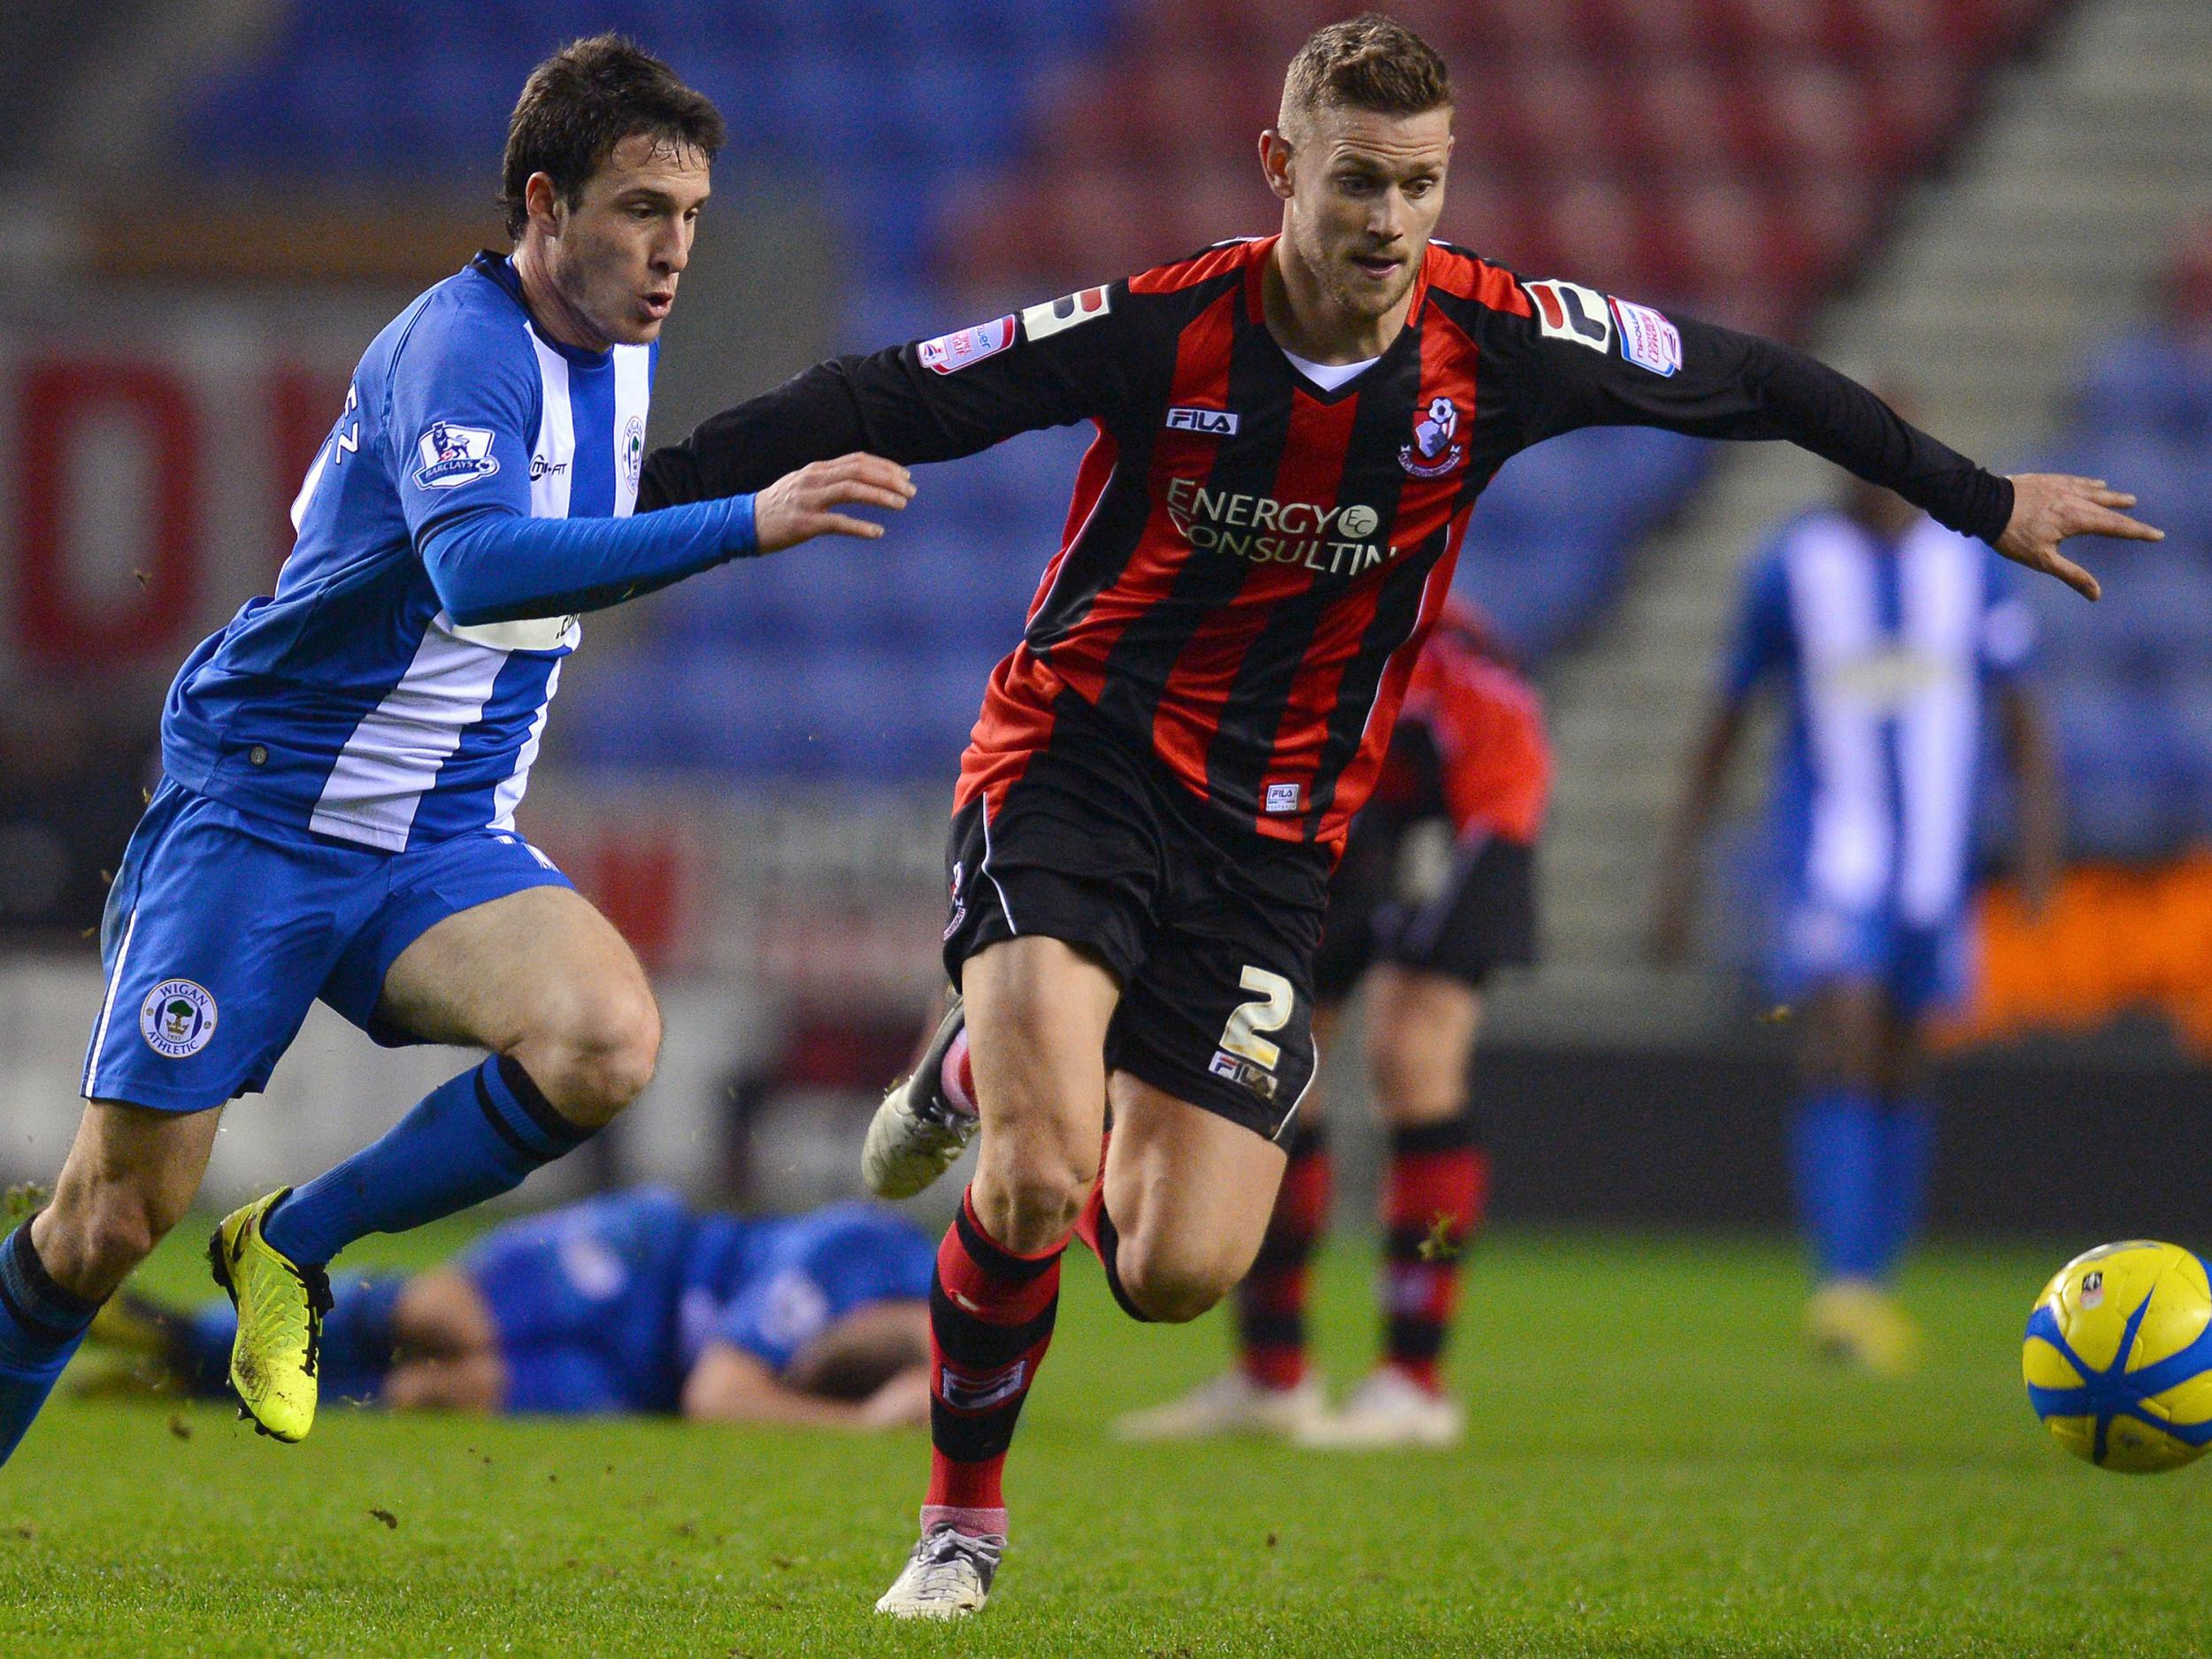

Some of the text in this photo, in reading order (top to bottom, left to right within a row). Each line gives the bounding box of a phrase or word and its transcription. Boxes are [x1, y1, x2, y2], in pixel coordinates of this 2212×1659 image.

[1171, 411, 1231, 433] FILA
[426, 461, 473, 479] BARCLAYS
[1167, 477, 1341, 534] ENERGY
[1271, 789, 1293, 798] FILA
[160, 983, 208, 1006] WIGAN
[1219, 964, 1294, 1071] 2
[147, 1031, 198, 1055] ATHLETIC
